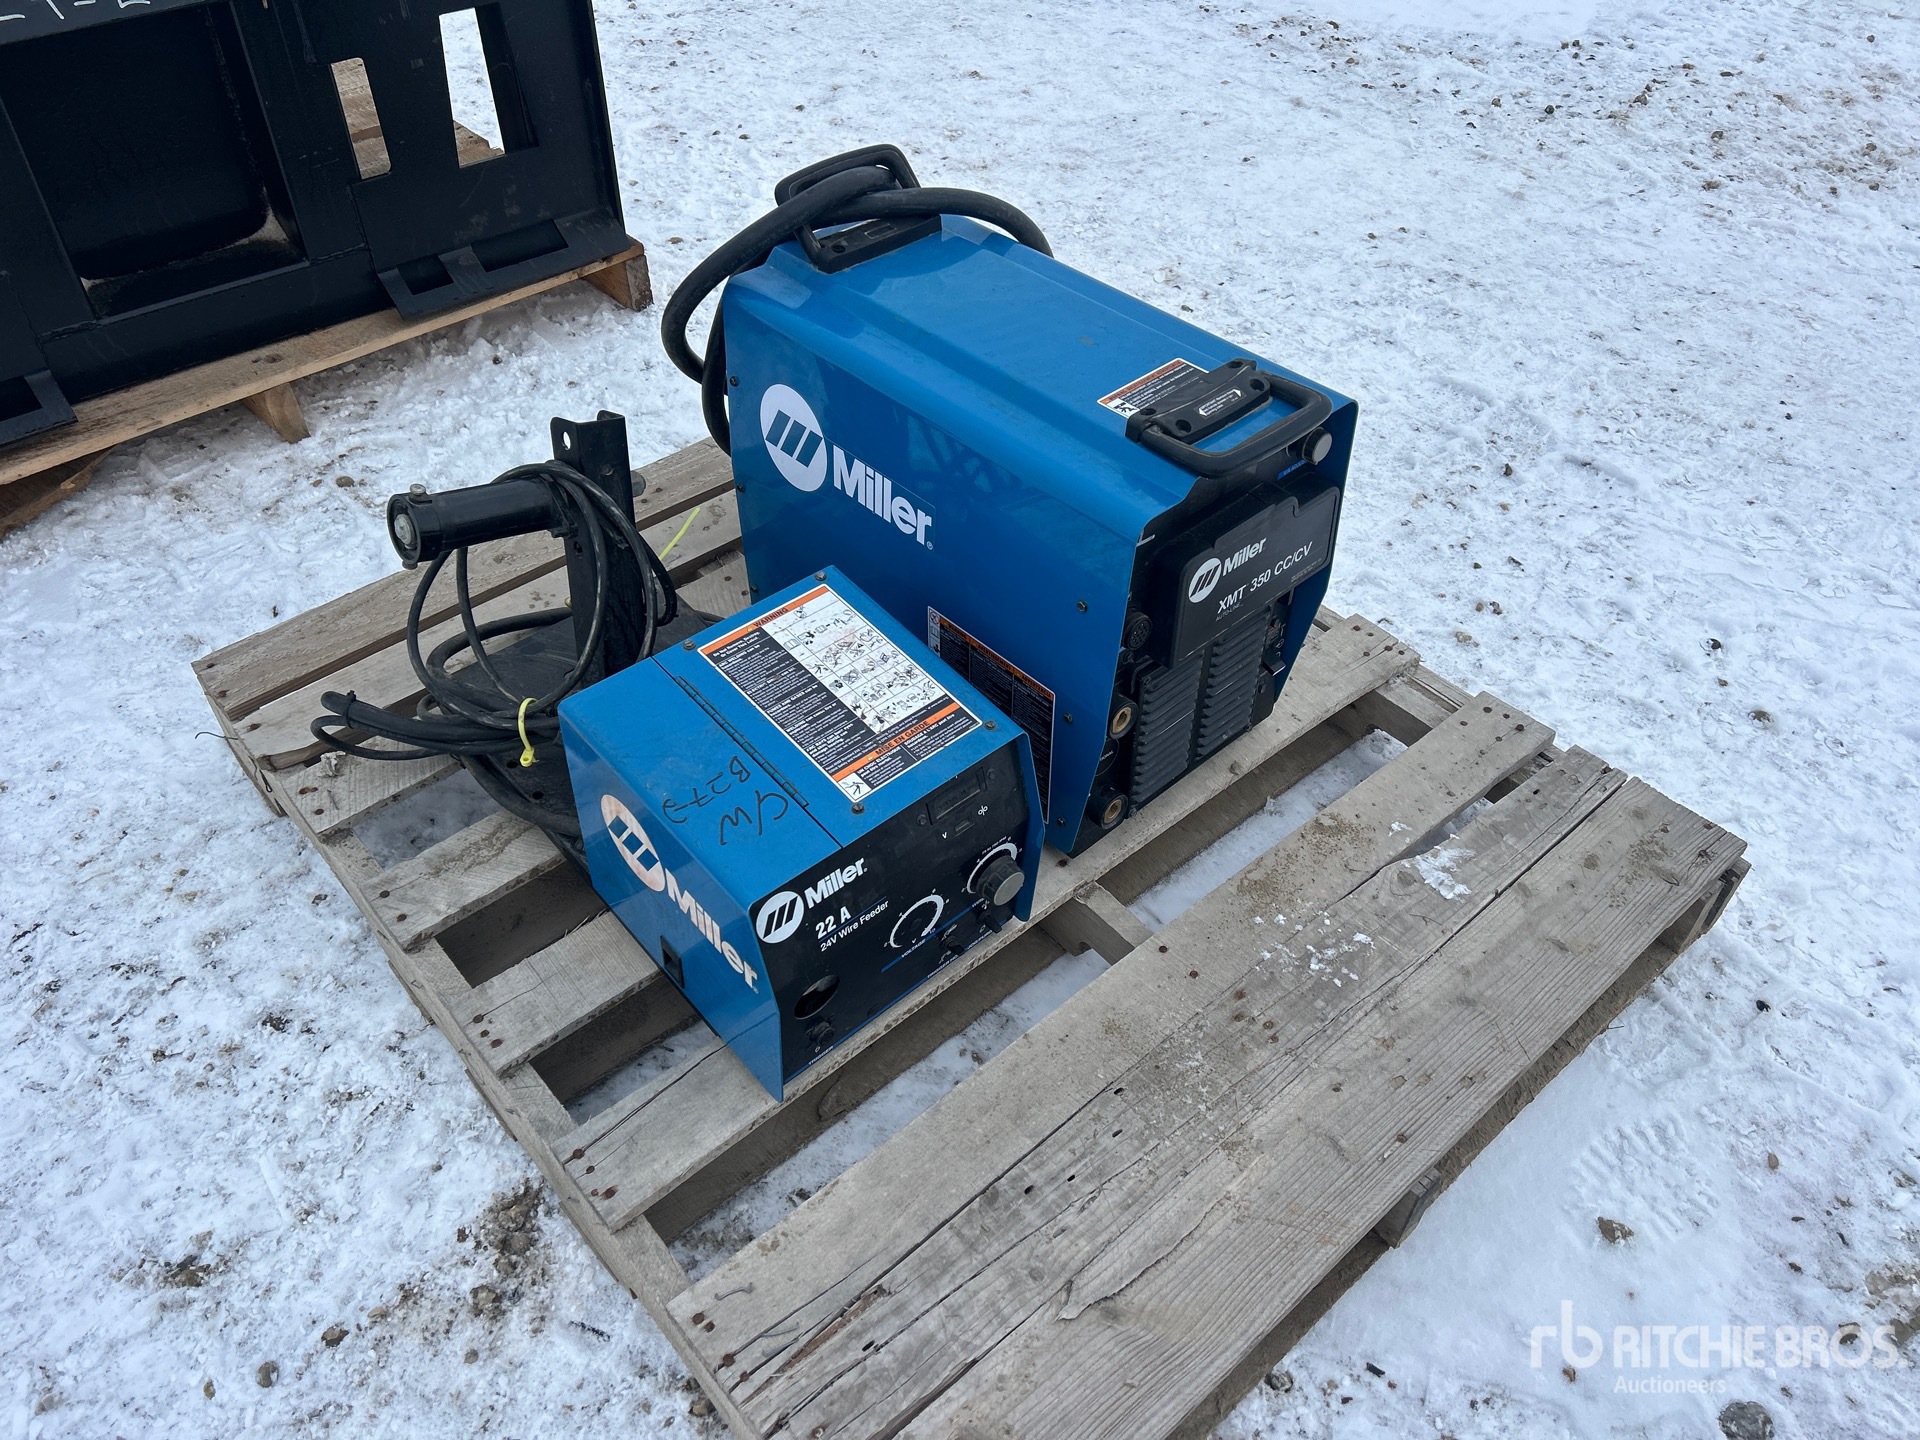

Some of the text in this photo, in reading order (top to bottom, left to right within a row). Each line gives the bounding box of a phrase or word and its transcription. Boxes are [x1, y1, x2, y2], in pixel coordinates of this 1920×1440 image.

[833, 445, 932, 546] Miller
[1217, 585, 1247, 613] XMT
[1250, 569, 1271, 592] 350
[1274, 541, 1313, 576] CC/CV
[1222, 538, 1267, 576] Miller
[752, 607, 789, 627] WARNING
[874, 741, 894, 755] MISE
[893, 735, 905, 744] EN
[903, 720, 929, 737] GARDE
[719, 789, 789, 845] C/W
[804, 857, 865, 909] Miller
[665, 868, 758, 989] Miller
[815, 906, 851, 940] 22 A
[820, 900, 889, 952] 24V Wire Feeder
